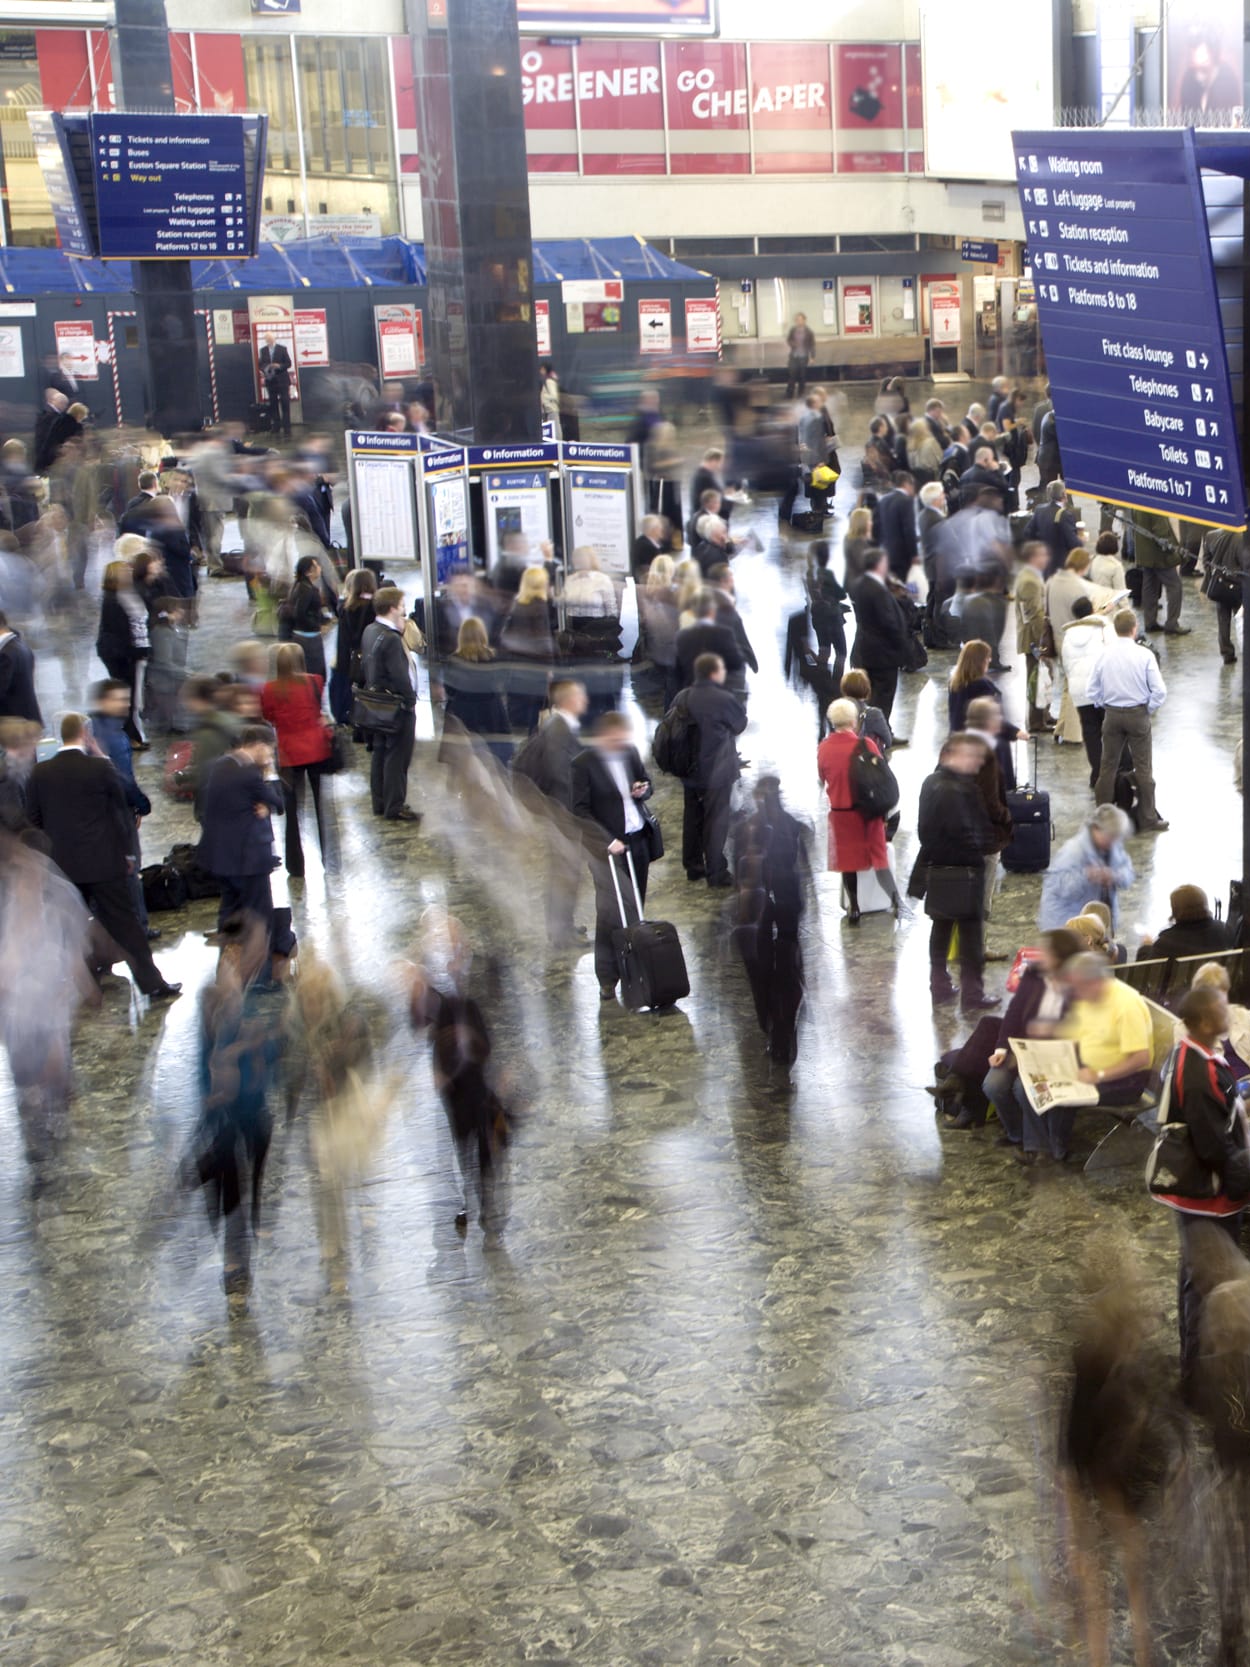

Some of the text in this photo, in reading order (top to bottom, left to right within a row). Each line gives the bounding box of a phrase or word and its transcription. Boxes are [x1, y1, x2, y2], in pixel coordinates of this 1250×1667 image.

[521, 67, 660, 104] GREENER
[677, 68, 715, 92] GO
[692, 82, 825, 119] CHEAPER
[127, 136, 210, 144] Tickets and information
[127, 149, 149, 157] Buses
[129, 161, 153, 170] Euston
[155, 162, 179, 171] Square
[181, 161, 206, 170] Station
[1048, 156, 1102, 177] Waiting room
[131, 174, 162, 183] Way out
[174, 193, 214, 202] Telephones
[1053, 189, 1135, 211] Left luggage Lost property
[172, 206, 185, 214] Left
[187, 206, 215, 215] luggage
[169, 218, 195, 227] Waiting
[157, 230, 217, 239] Station reception
[1059, 222, 1128, 244] Station reception
[155, 243, 189, 251] Platforms
[191, 243, 199, 251] 12
[200, 243, 207, 251] to
[1063, 254, 1158, 279] Tickets and information
[1068, 287, 1137, 310] Platforms 8 to 18
[1102, 338, 1174, 367] First class lounge
[1129, 375, 1179, 398] Telephones
[1144, 409, 1184, 432] Babycare
[367, 436, 411, 446] Information
[434, 454, 461, 465] Information
[493, 449, 544, 459] Information
[578, 447, 624, 457] Information
[1159, 444, 1188, 464] Toilets
[1128, 469, 1192, 498] Platforms 1 to 7
